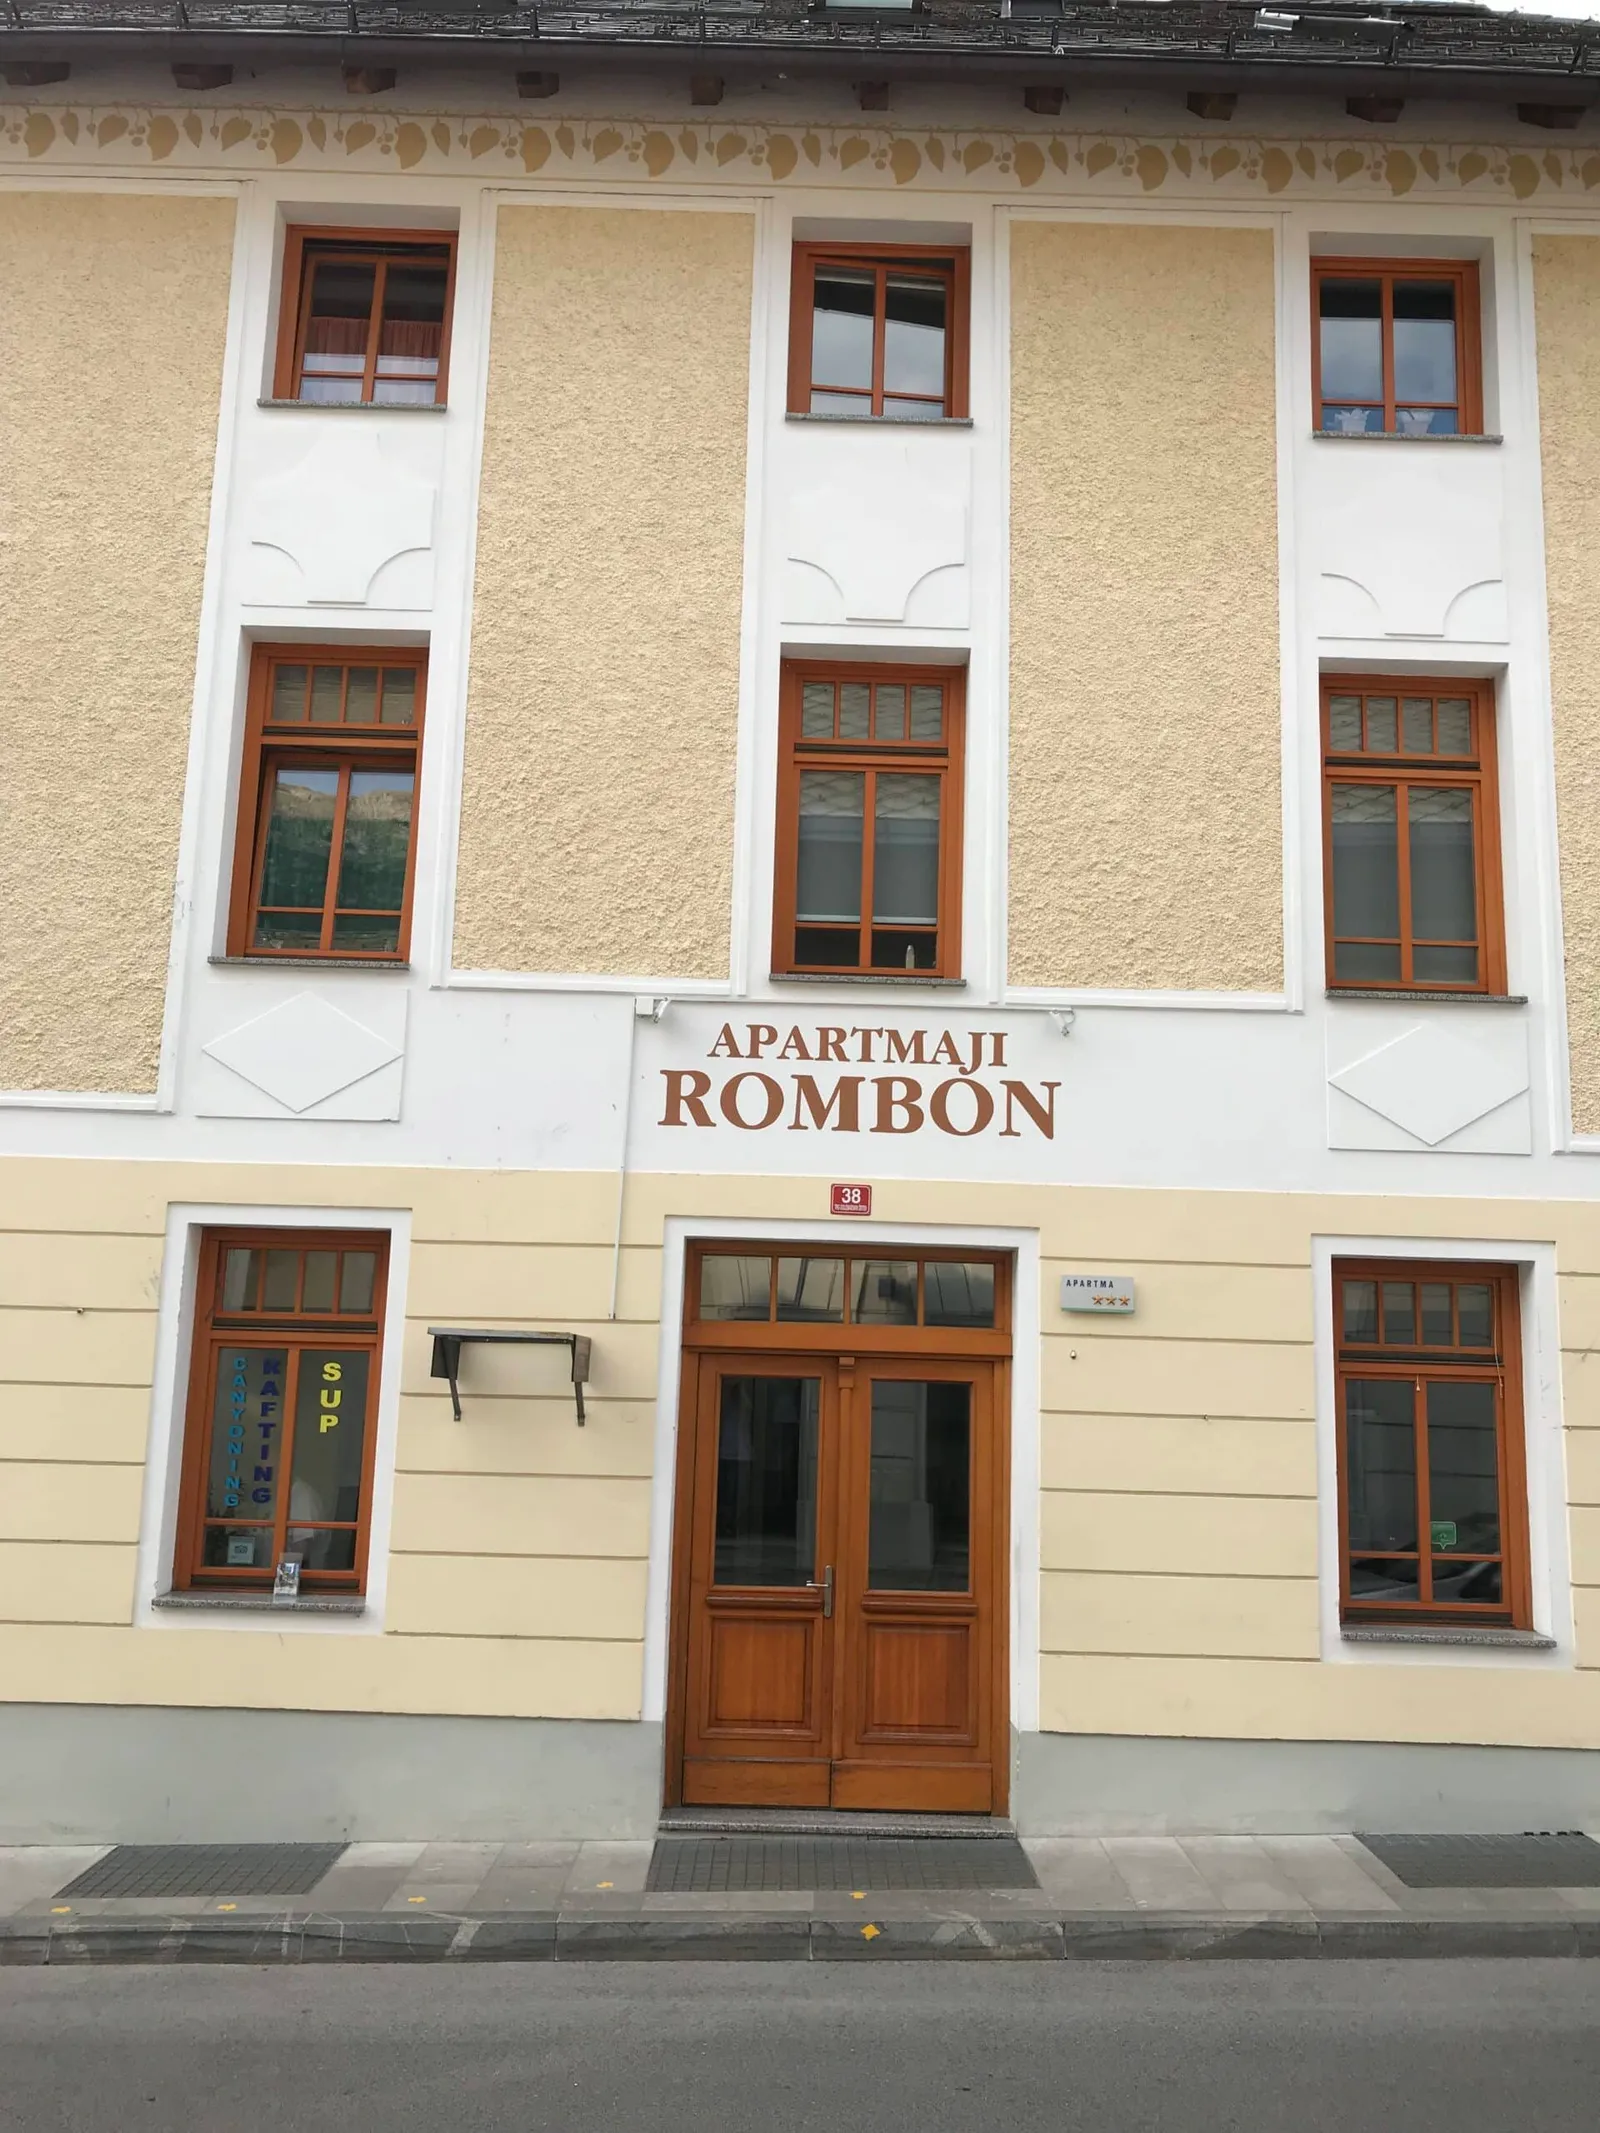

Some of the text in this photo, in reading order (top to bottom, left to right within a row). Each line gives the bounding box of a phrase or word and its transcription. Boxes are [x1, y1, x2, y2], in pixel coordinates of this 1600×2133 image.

[706, 1022, 1008, 1075] APARTMAJI
[657, 1069, 1062, 1140] ROMBON
[841, 1188, 861, 1204] 38
[1066, 1279, 1114, 1289] APARTMA
[320, 1362, 342, 1433] SUP
